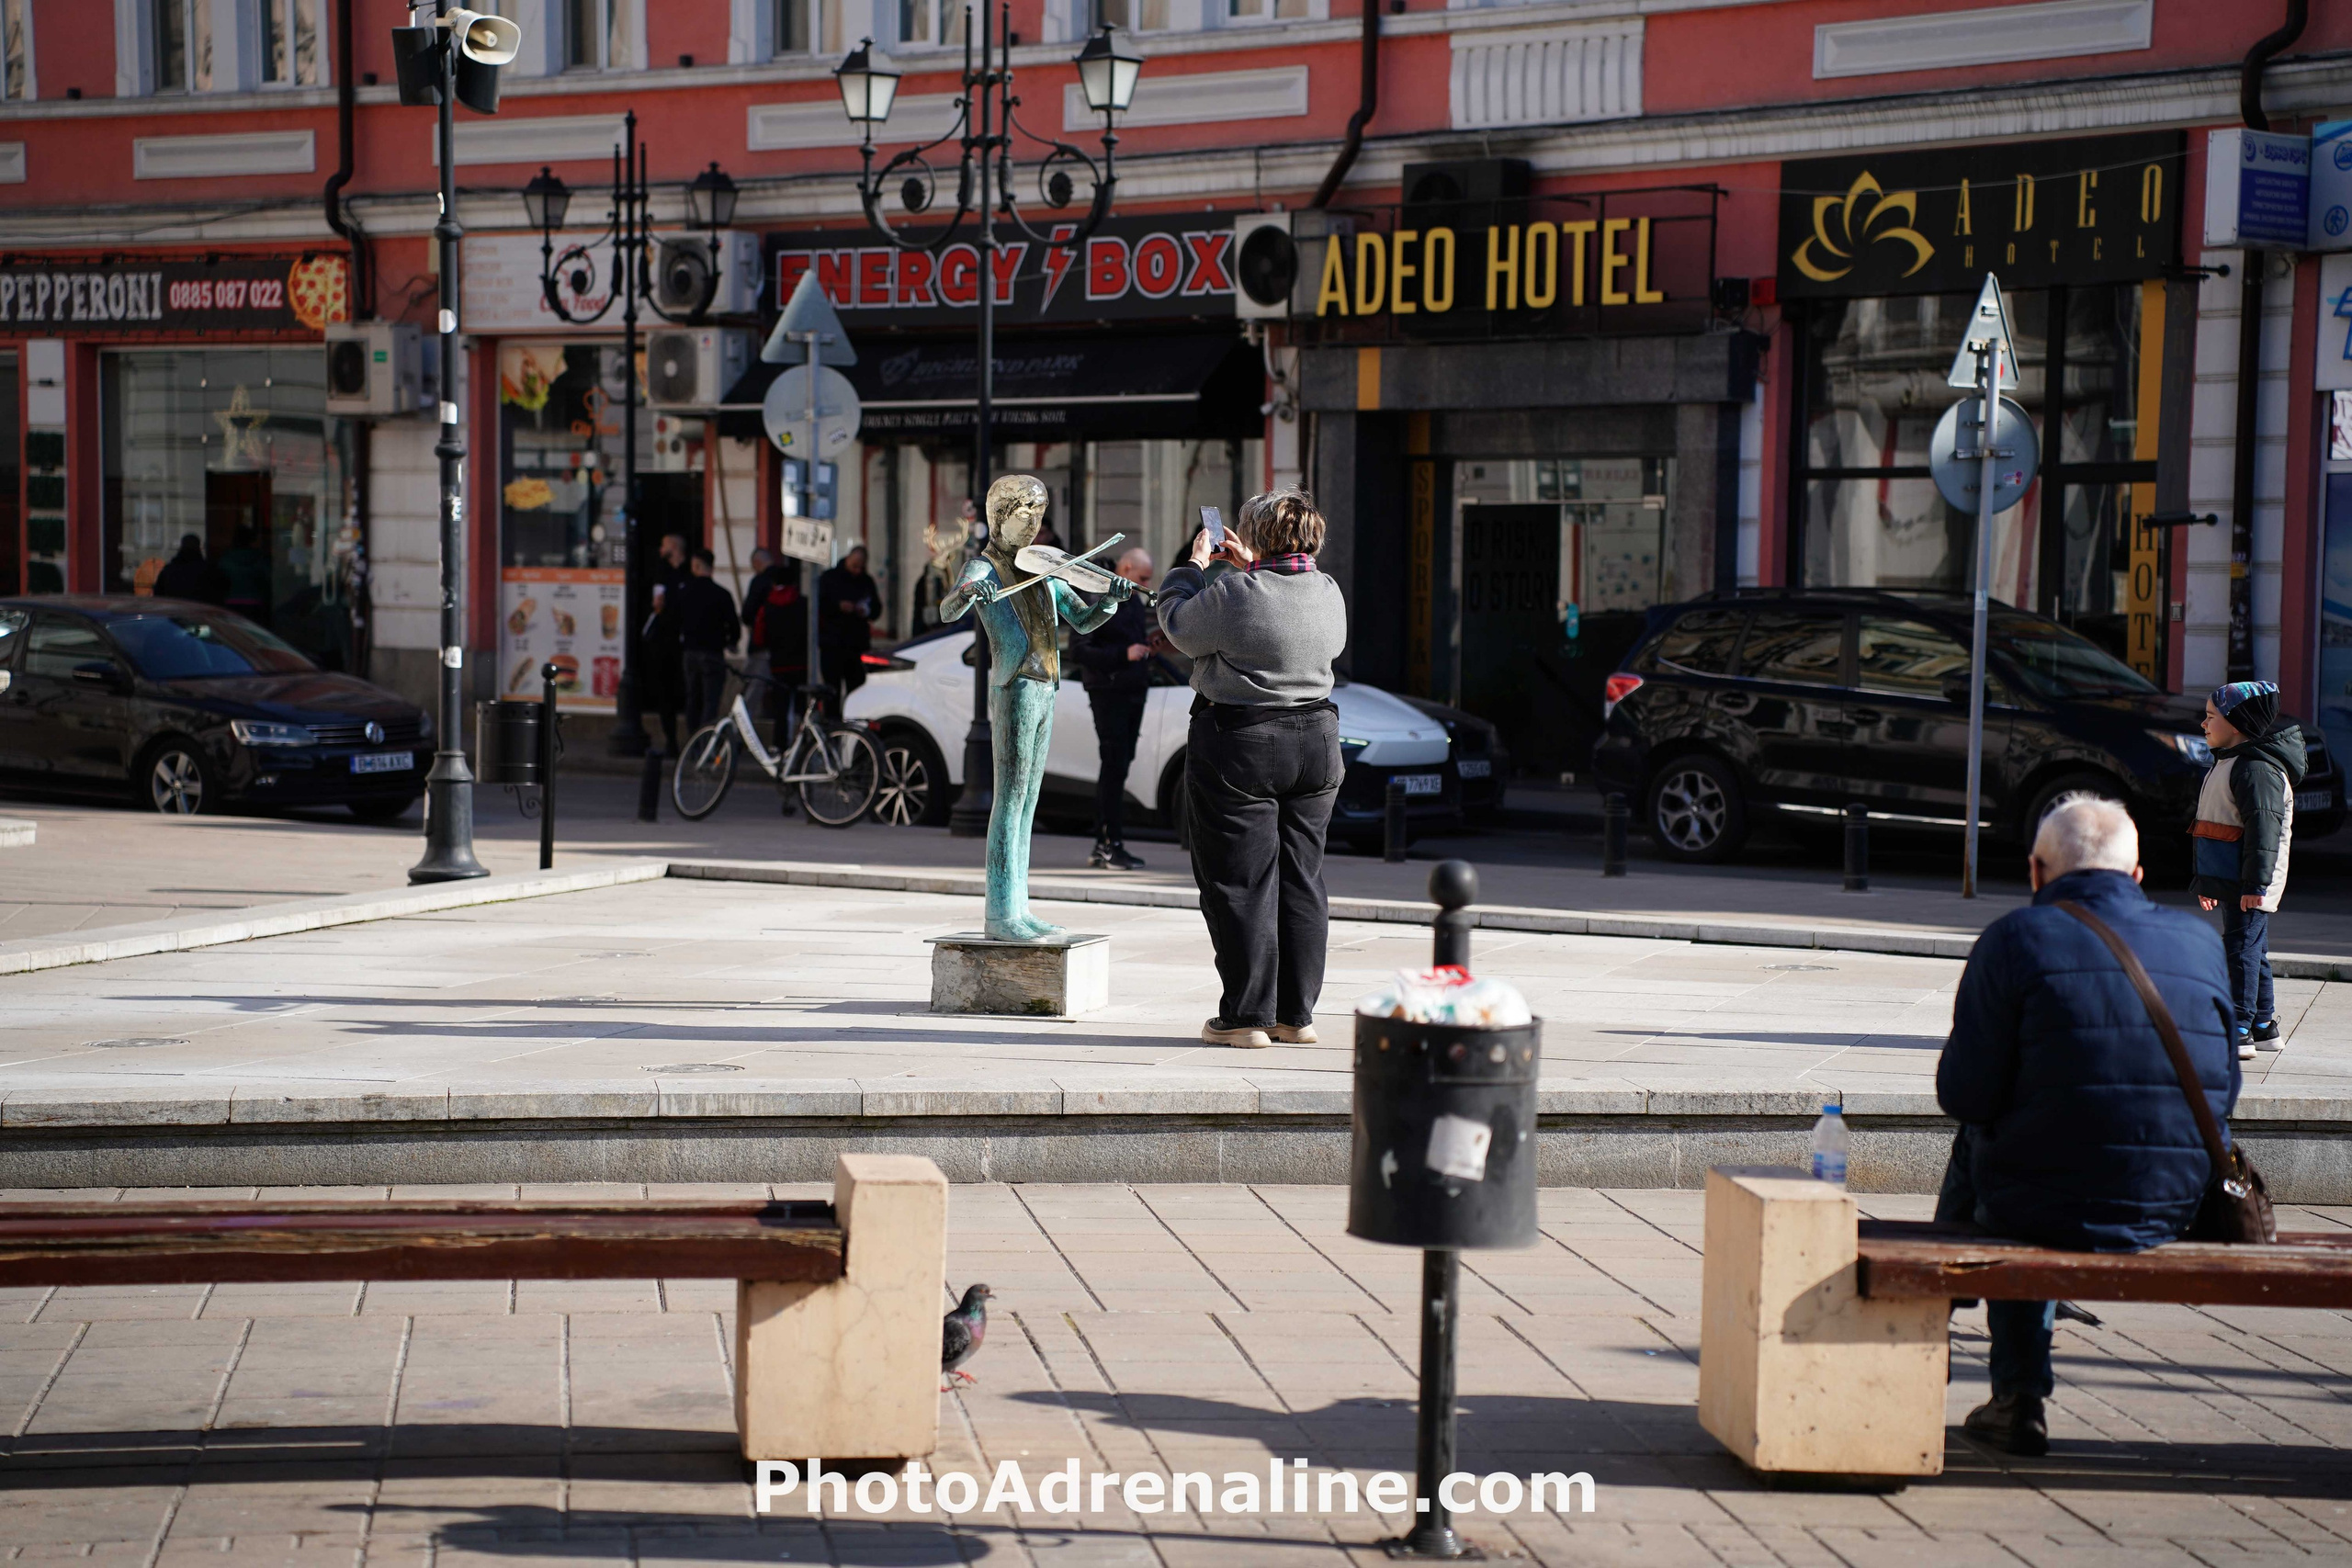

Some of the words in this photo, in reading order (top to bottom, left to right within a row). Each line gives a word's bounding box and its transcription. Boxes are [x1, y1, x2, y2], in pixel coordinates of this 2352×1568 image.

[1953, 164, 2164, 236] ADEO
[776, 243, 1030, 309] ENERGY
[1085, 231, 1237, 301] BOX
[1316, 227, 1455, 317] ADEO
[1486, 217, 1664, 310] HOTEL
[1964, 235, 2145, 268] HOTEL
[0, 272, 163, 321] PEPPERONI
[169, 280, 212, 310] 0885
[215, 280, 244, 309] 087
[250, 279, 283, 308] 022
